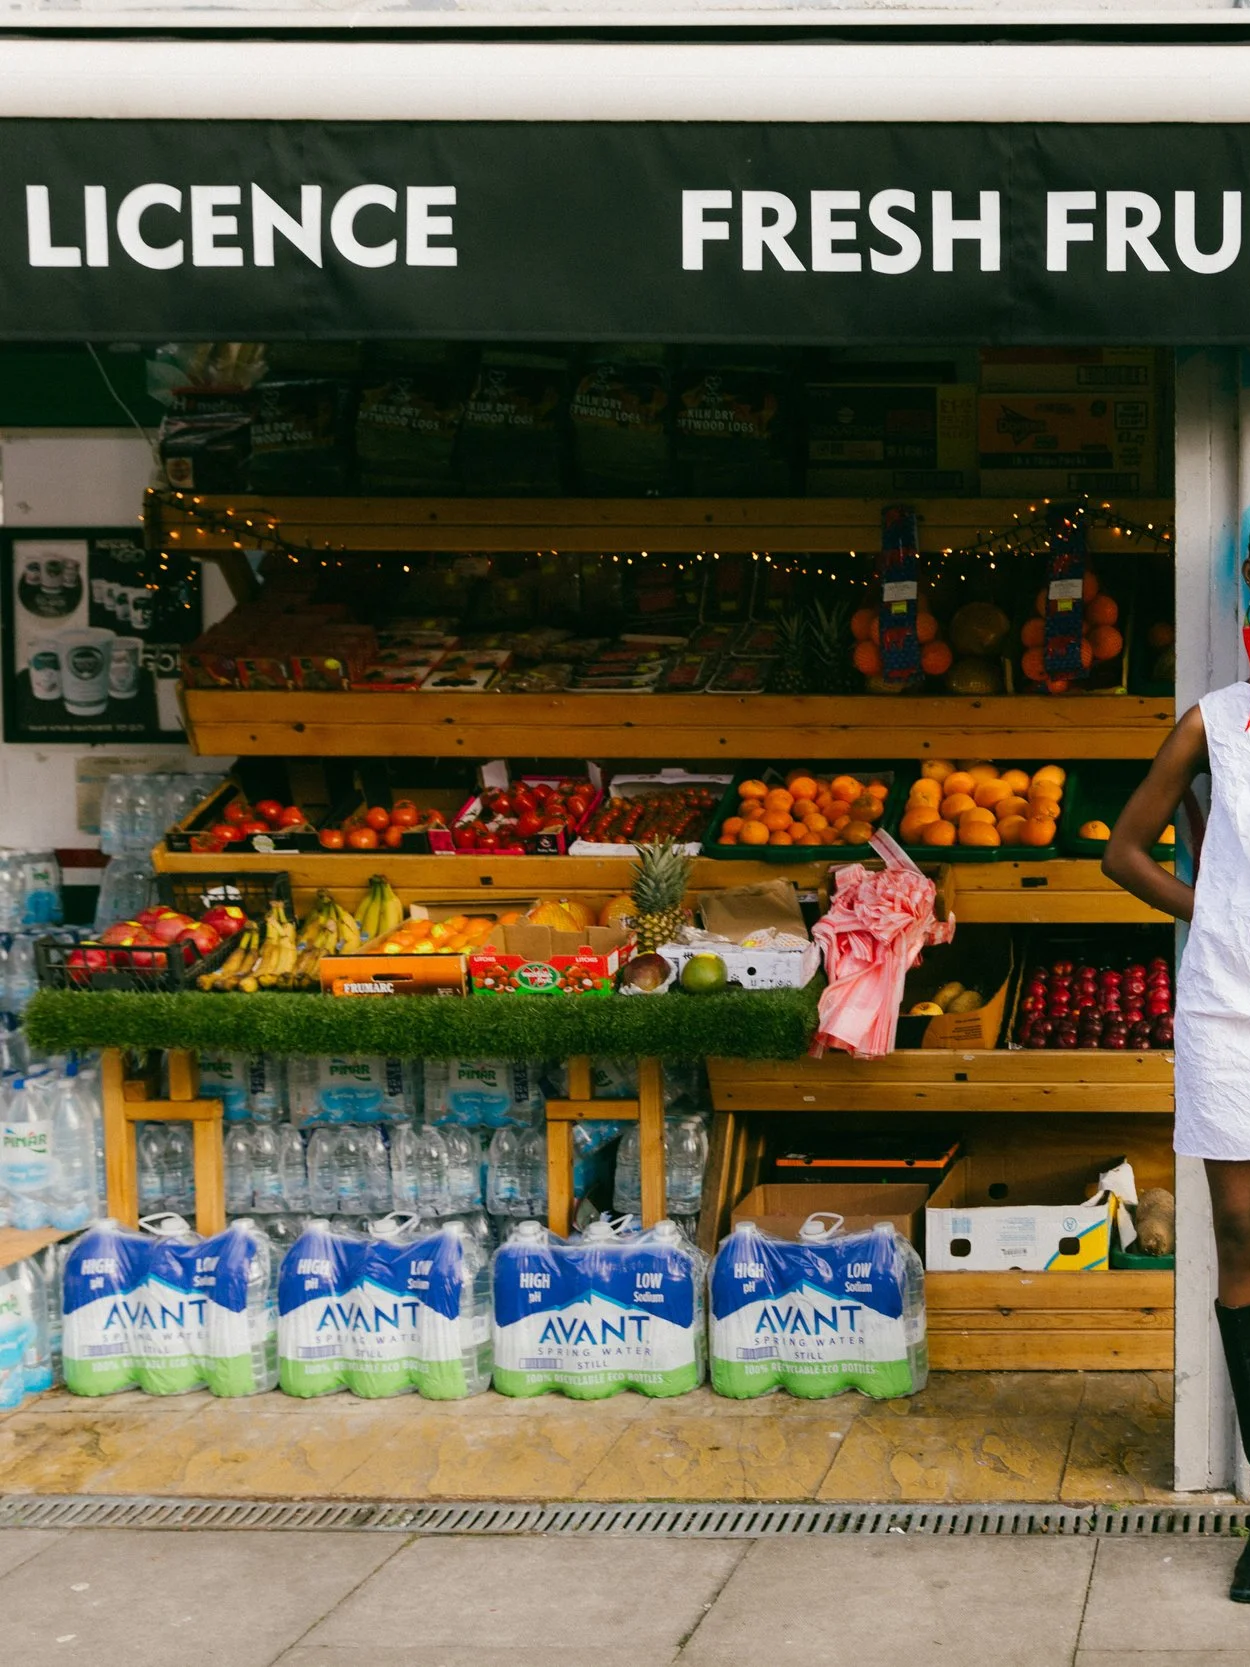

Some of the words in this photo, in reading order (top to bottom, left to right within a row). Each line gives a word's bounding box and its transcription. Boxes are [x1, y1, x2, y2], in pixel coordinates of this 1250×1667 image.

[27, 183, 457, 269] LICENCE
[683, 189, 1000, 274] FRESH
[714, 409, 735, 421] DRY
[728, 421, 754, 433] LOGS
[343, 981, 395, 995] FRUMARC
[297, 1258, 333, 1277] HIGH
[734, 1262, 765, 1280] HIGH
[846, 1262, 873, 1280] LOW
[519, 1272, 552, 1290] HIGH
[635, 1272, 664, 1290] LOW
[742, 1281, 757, 1296] pH
[843, 1280, 874, 1295] Sodium
[528, 1290, 543, 1306] pH
[633, 1290, 665, 1304] Sodium
[104, 1299, 208, 1331] AVANT
[316, 1301, 421, 1333] AVANT
[754, 1304, 863, 1336] AVANT
[538, 1314, 651, 1346] AVANT
[754, 1336, 812, 1347] SPRING
[816, 1335, 866, 1346] WATER
[537, 1346, 592, 1358] SPRING
[601, 1345, 653, 1358] WATER
[794, 1350, 824, 1362] STILL
[577, 1359, 608, 1371] STILL
[743, 1362, 770, 1376] 100%
[525, 1373, 554, 1387] 100%
[608, 1372, 626, 1386] ECO
